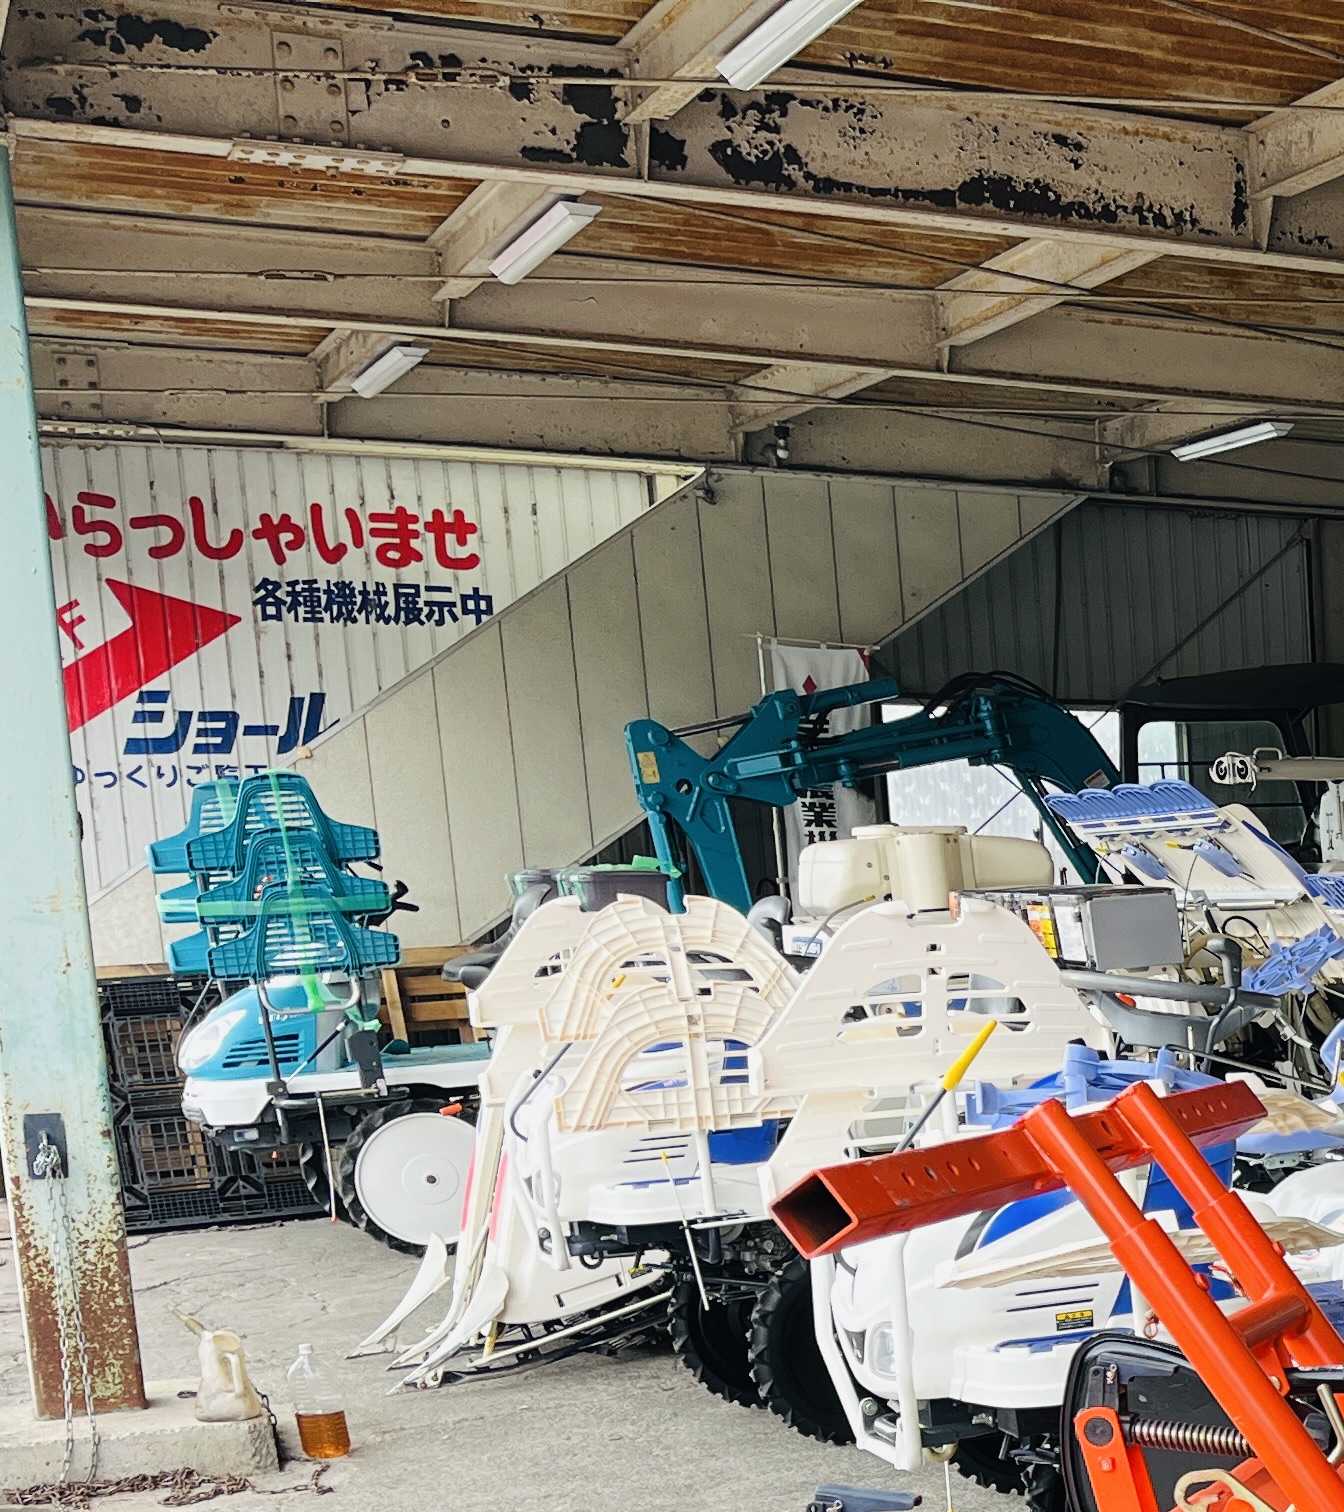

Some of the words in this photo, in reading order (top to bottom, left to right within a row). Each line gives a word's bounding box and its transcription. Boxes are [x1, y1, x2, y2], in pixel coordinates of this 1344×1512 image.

[253, 577, 493, 627] 各種機械展示中
